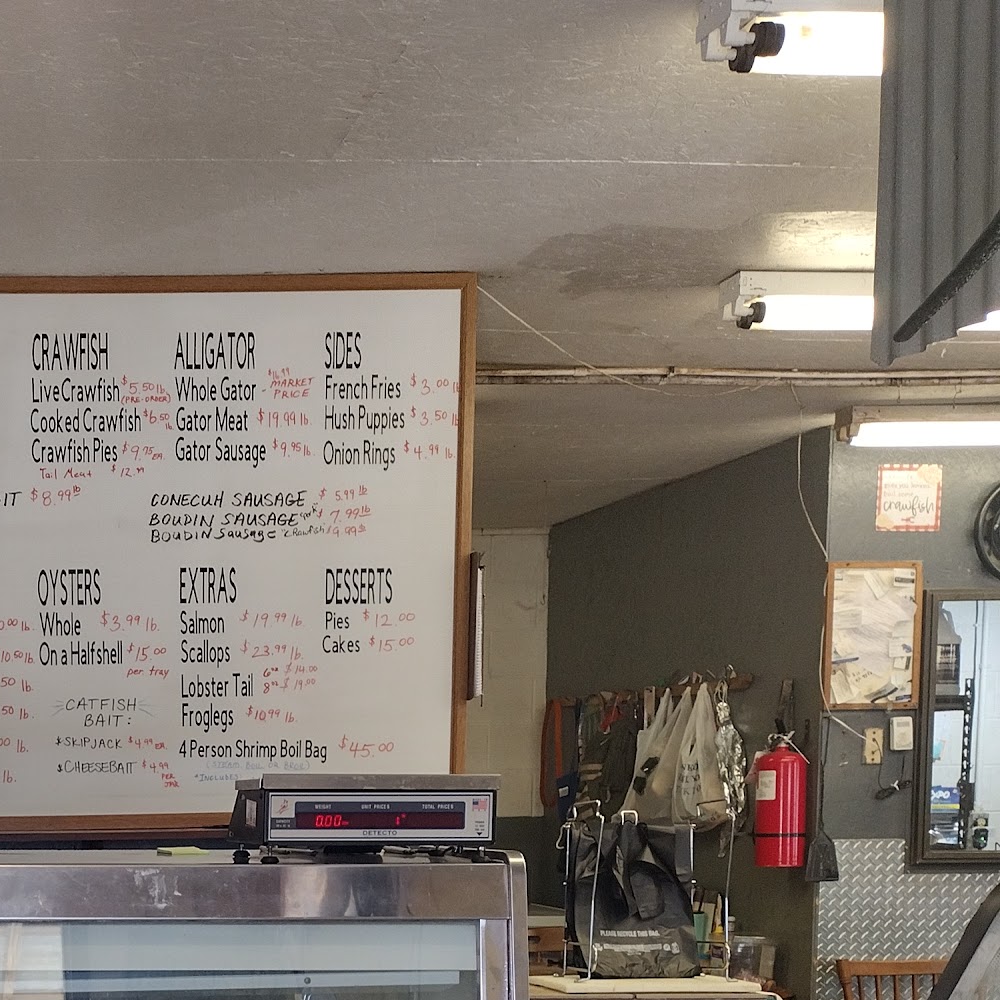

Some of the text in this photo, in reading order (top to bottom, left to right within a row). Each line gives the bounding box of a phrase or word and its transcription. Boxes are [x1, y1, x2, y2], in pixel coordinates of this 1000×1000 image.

[31, 332, 109, 371] CRAWFISH
[174, 332, 256, 370] ALLIGATOR
[324, 331, 362, 370] SIDES
[175, 376, 257, 403] Whole Gator
[269, 376, 315, 389] MARKET
[273, 388, 310, 400] PRICE
[324, 374, 368, 400] French
[370, 374, 402, 400] Fries
[30, 407, 142, 433] Cooked Crawfish
[175, 406, 213, 432] Gator
[215, 406, 249, 432] Meat
[324, 405, 355, 430] Hush
[358, 405, 406, 435] Puppies
[31, 437, 119, 463] Crawfish Pies
[175, 436, 267, 468] Gator Sausage
[323, 440, 361, 466] Onion
[362, 440, 396, 471] Rings
[150, 490, 308, 508] CONECUH SAUSAGE
[883, 495, 935, 517] crawfish
[149, 511, 300, 528] BOUDIN SAUSAGE
[150, 527, 214, 543] BOUDIN
[37, 568, 101, 606] OYSTERS
[179, 567, 237, 604] EXTRAS
[324, 567, 393, 605] DESSERTS
[39, 612, 81, 636] Whole
[180, 610, 226, 635] Salmon
[324, 610, 350, 630] Pies
[39, 641, 58, 666] On
[180, 639, 231, 668] Scallops
[322, 635, 361, 654] Cakes
[149, 665, 170, 680] tray
[181, 673, 254, 698] Lobster Tail
[65, 697, 137, 711] CATFISH
[181, 703, 234, 734] Froglegs
[178, 739, 187, 758] 4
[188, 739, 233, 759] Person
[235, 739, 278, 763] Shrimp
[280, 739, 303, 759] Boil
[304, 739, 328, 763] Bag
[362, 829, 398, 837] DETECTO
